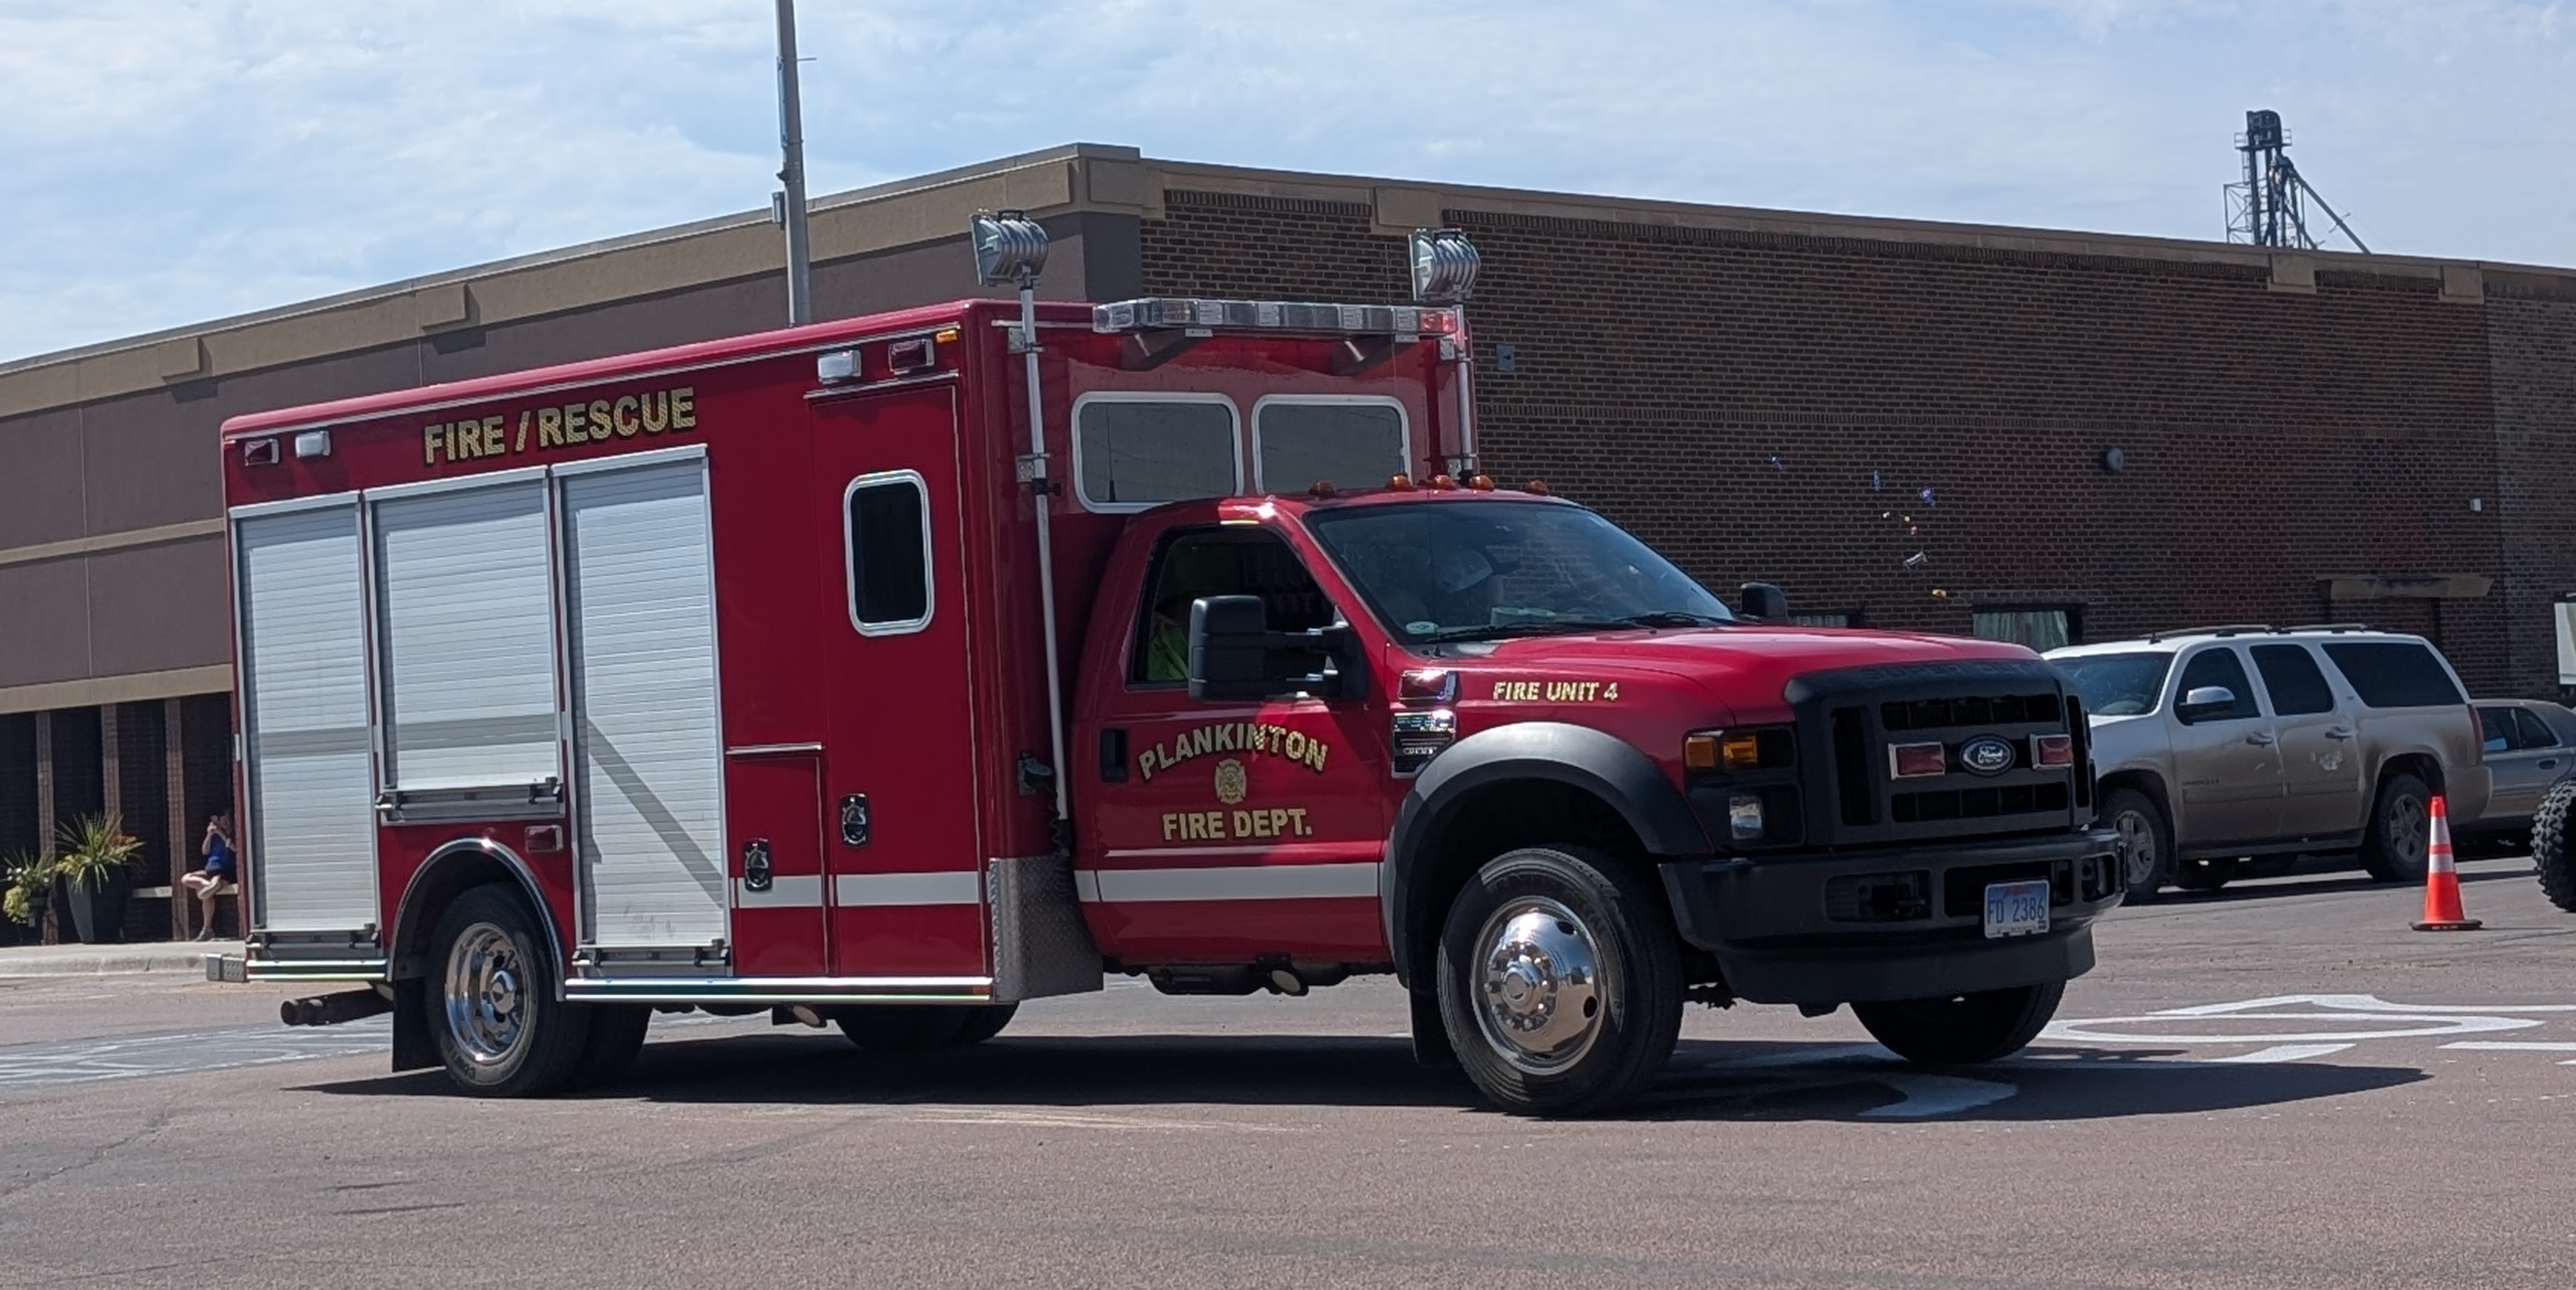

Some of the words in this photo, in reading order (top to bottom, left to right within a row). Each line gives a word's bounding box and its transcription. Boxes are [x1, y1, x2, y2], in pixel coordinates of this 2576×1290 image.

[424, 415, 505, 464] FIRE
[537, 387, 696, 447] RESCUE
[1494, 682, 1540, 700] FIRE
[1546, 682, 1600, 701] UNIT
[1604, 682, 1619, 700] 4
[1139, 723, 1329, 781] PLANKINTON
[1162, 812, 1226, 841] FIRE
[1233, 809, 1313, 838] DEPT.
[1987, 900, 2004, 925] FD
[2012, 897, 2046, 923] 2386
